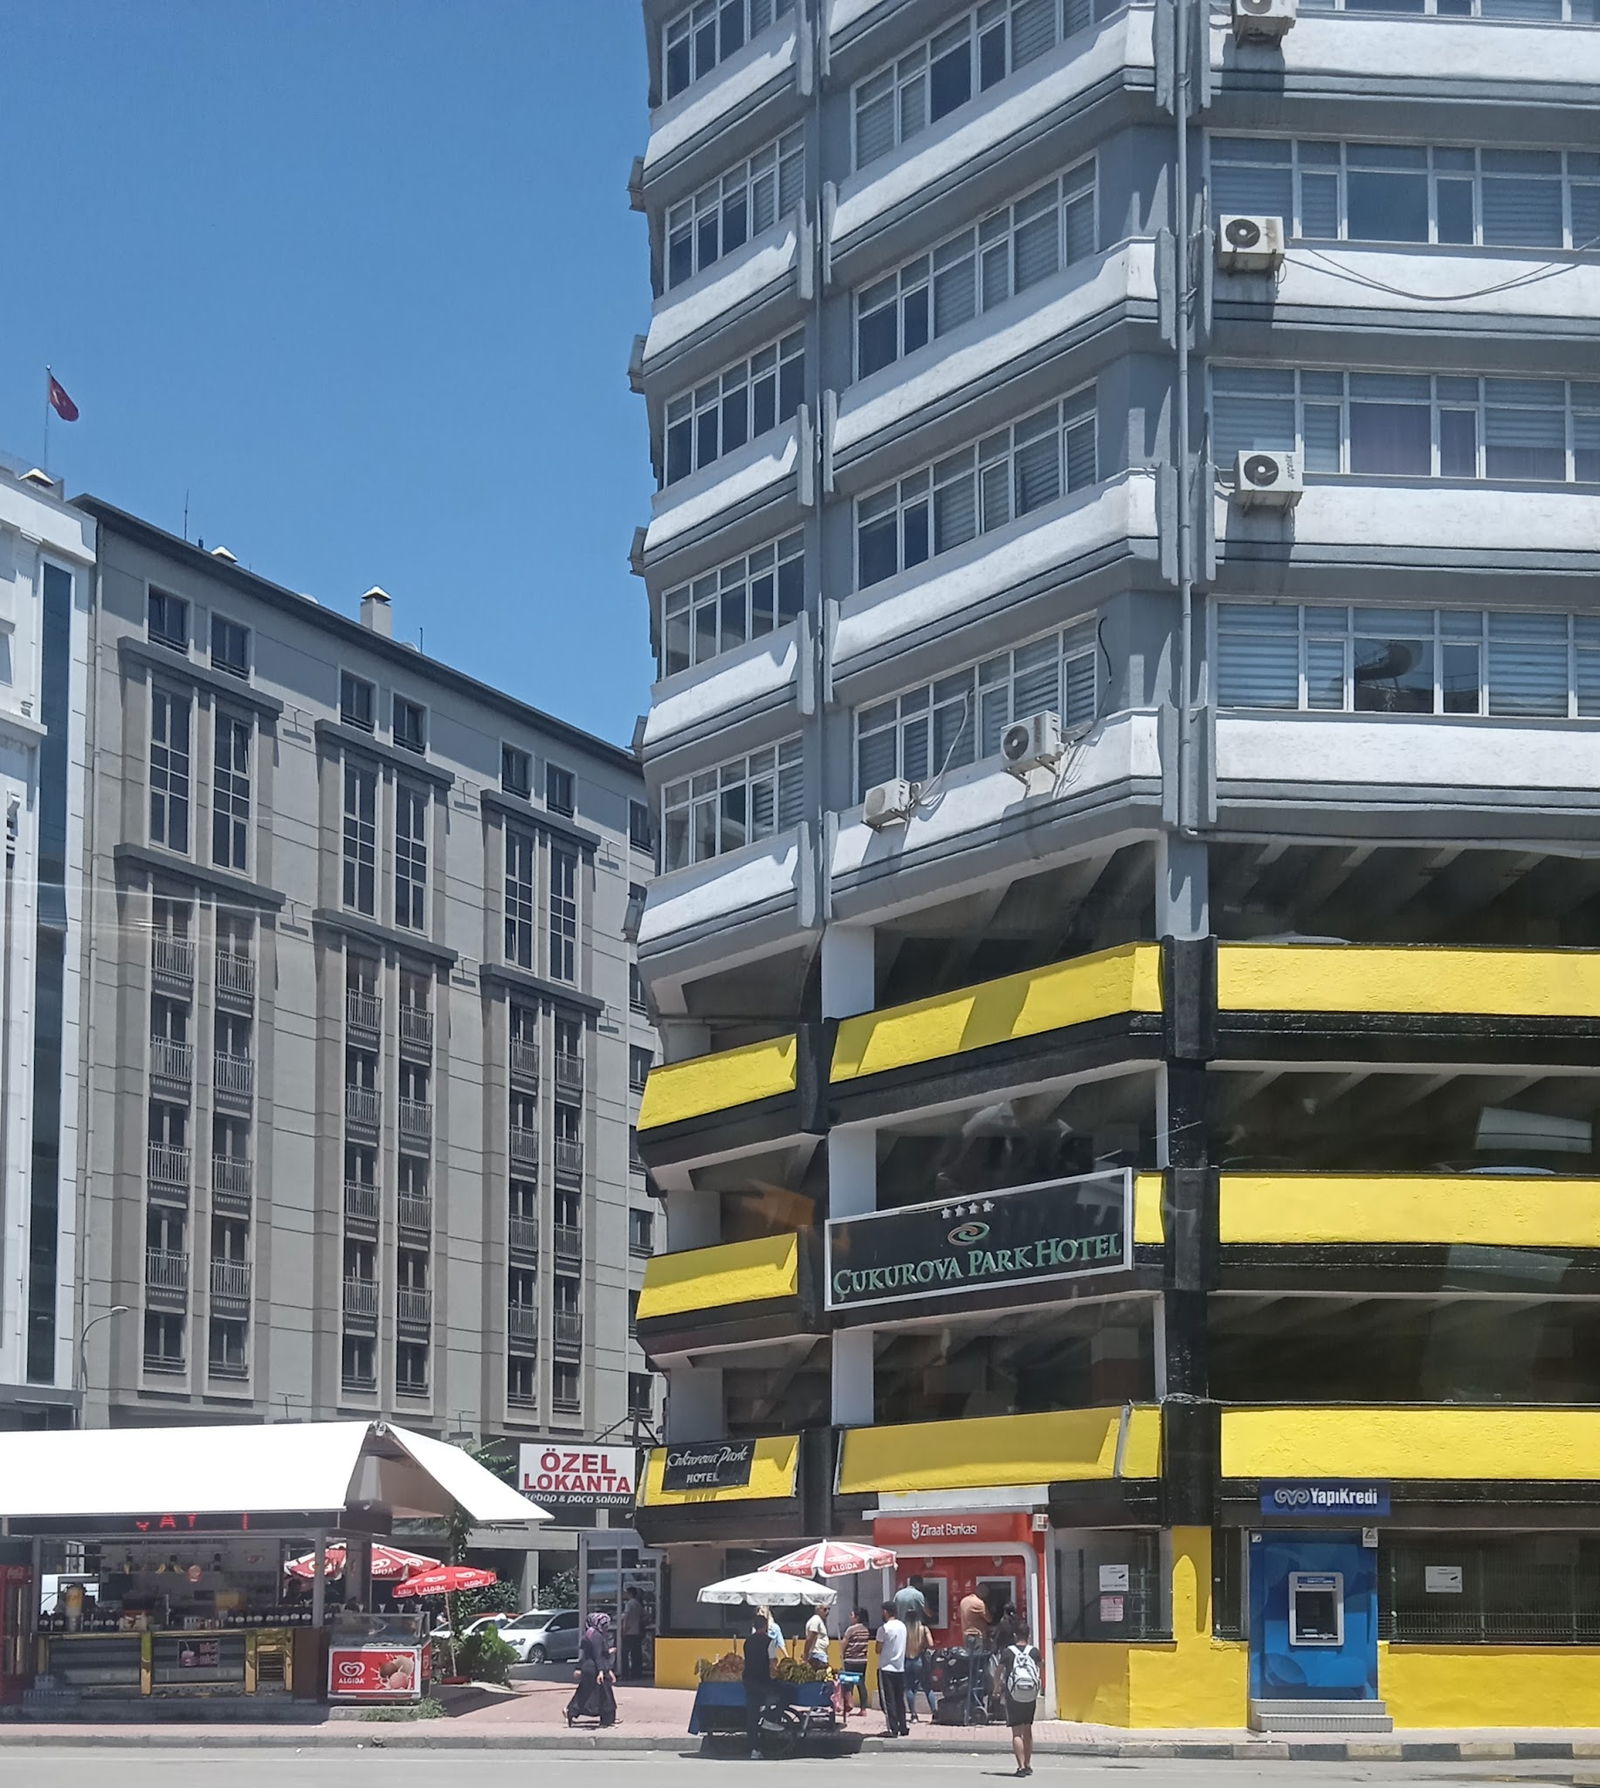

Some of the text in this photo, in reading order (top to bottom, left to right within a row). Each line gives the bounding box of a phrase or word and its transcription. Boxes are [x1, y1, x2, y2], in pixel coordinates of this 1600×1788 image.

[833, 1233, 1121, 1301] ÇUKUROVA PARK HOTEL
[540, 1448, 616, 1474] ÖZEL
[717, 1444, 749, 1467] Park
[524, 1473, 631, 1493] LOKANTA
[686, 1472, 720, 1484] HOTEL
[596, 1494, 630, 1505] salonu
[920, 1522, 977, 1537] Ziraat Bankası
[830, 1562, 858, 1573] ALGIDA
[338, 1677, 365, 1685] ALGIDA
